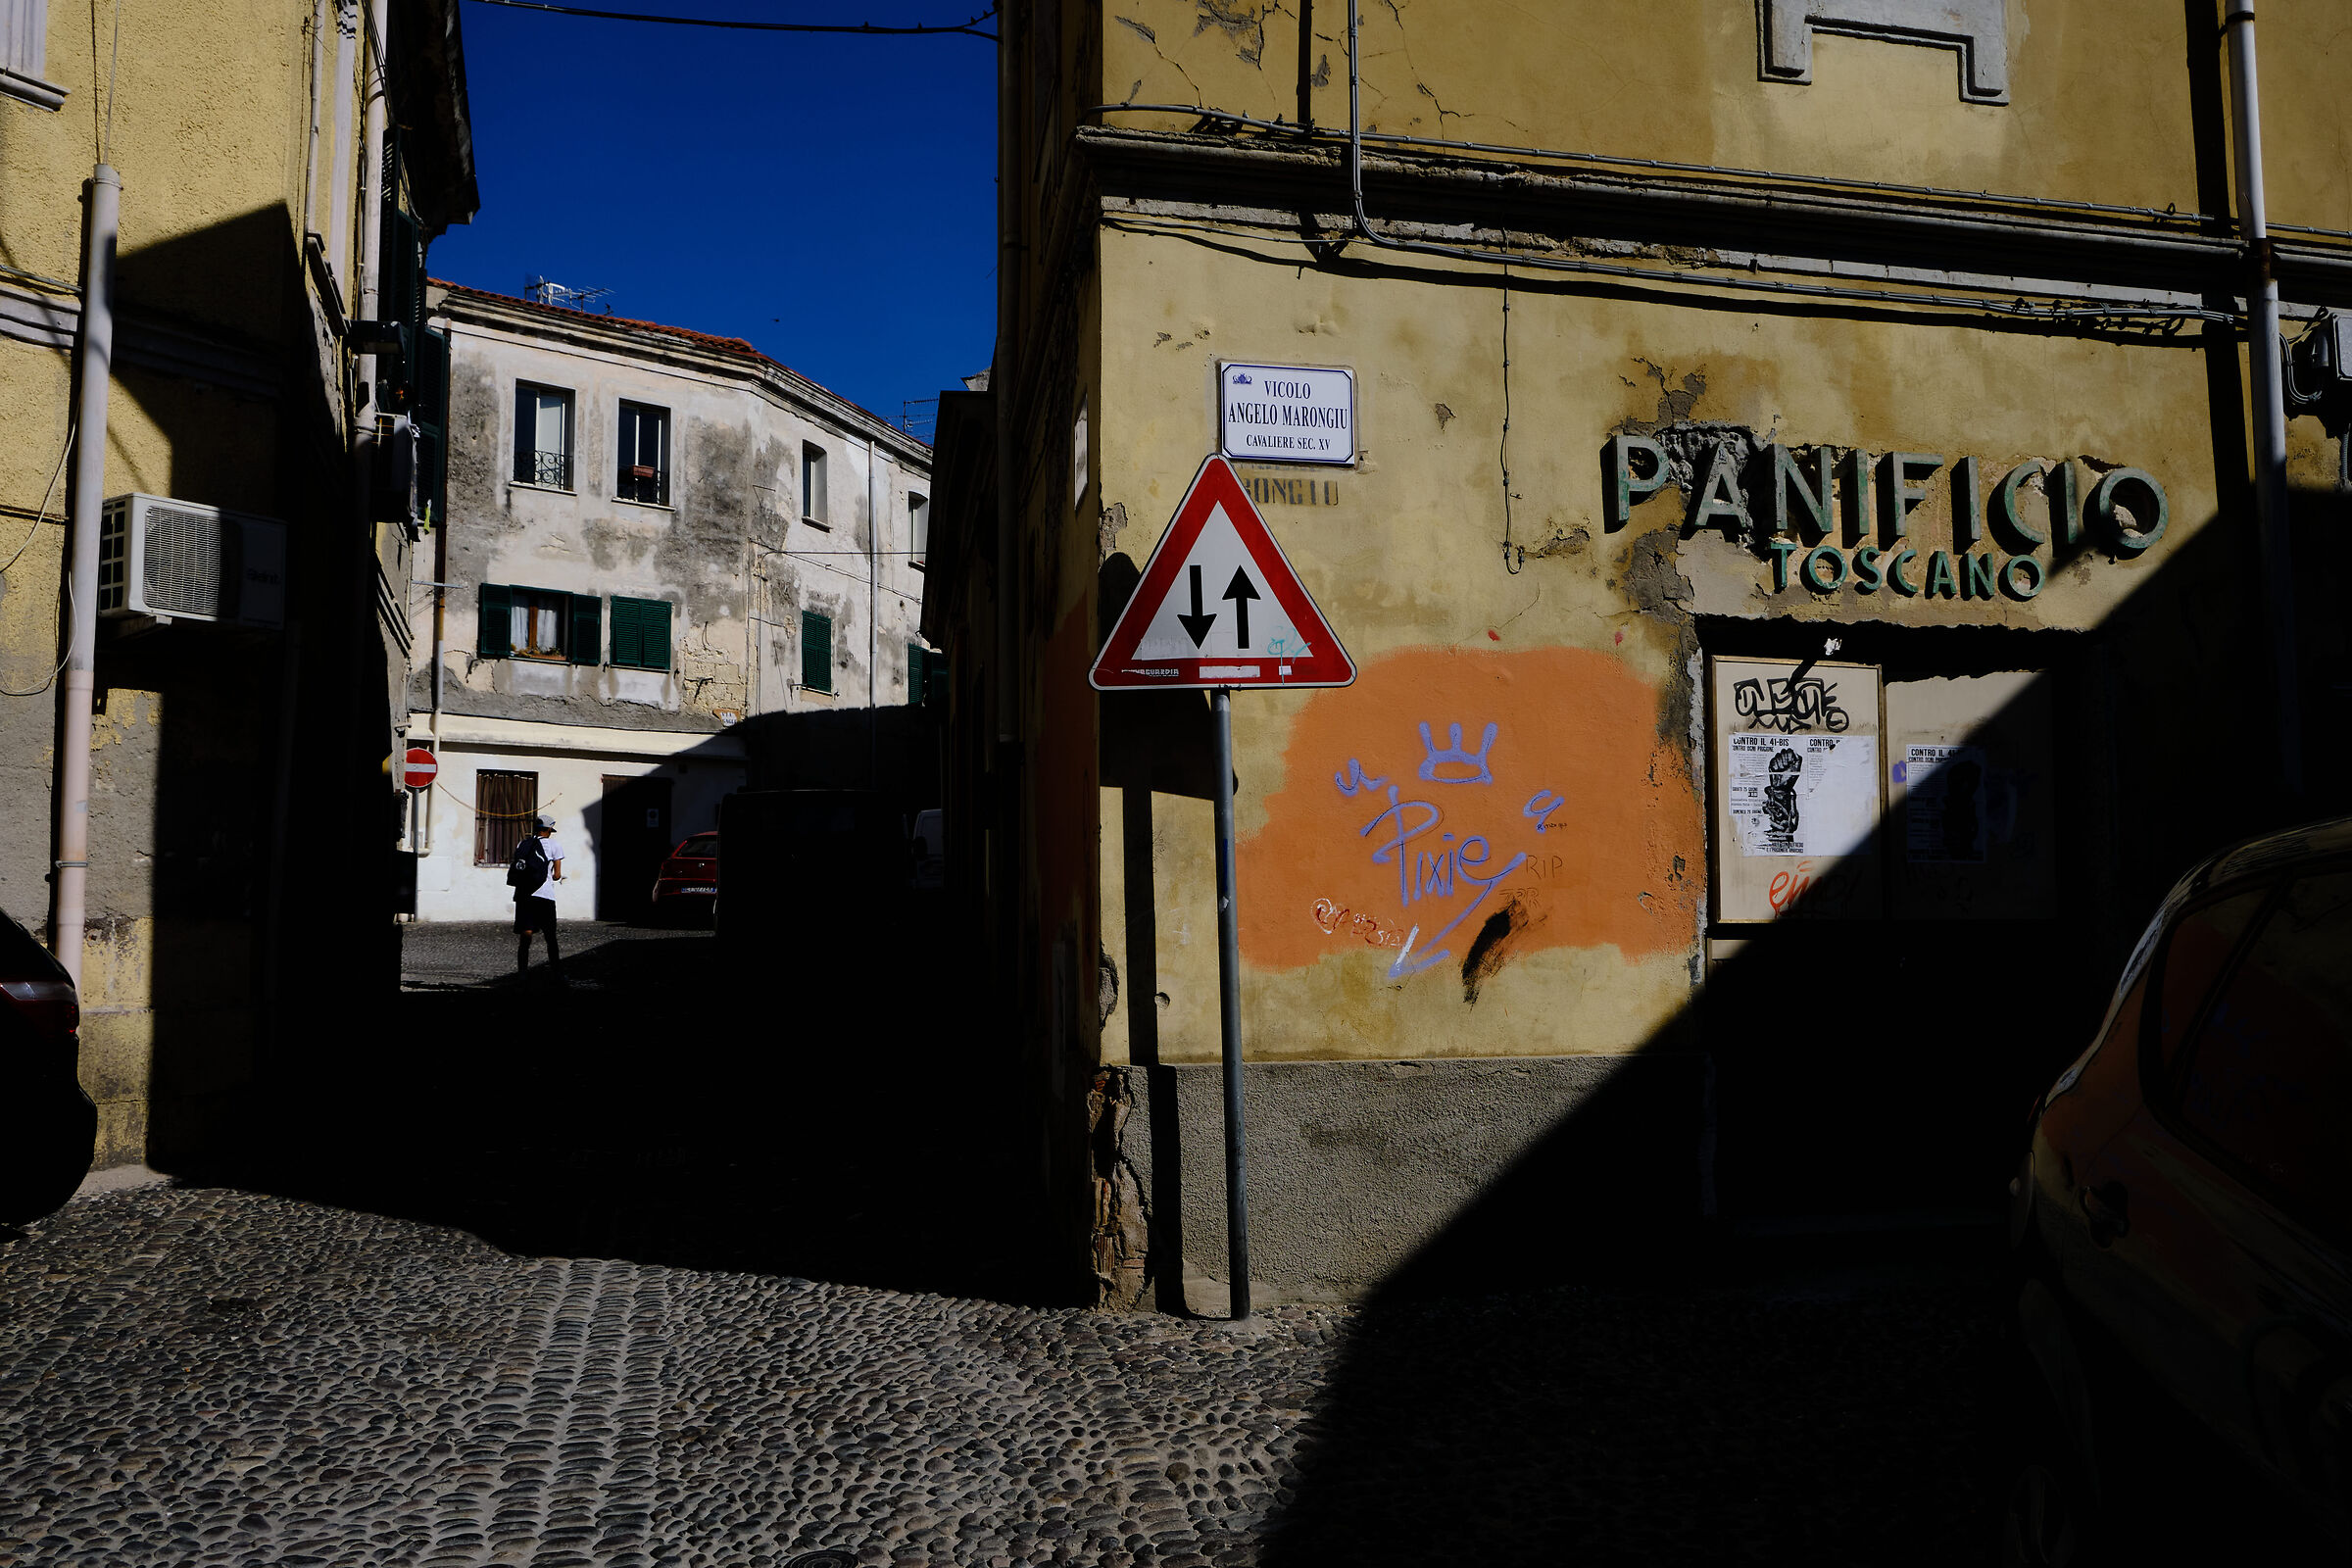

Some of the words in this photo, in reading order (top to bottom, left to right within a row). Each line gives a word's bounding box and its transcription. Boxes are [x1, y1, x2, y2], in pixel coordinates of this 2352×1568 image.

[1264, 380, 1311, 399] VICOLO
[1228, 403, 1278, 425] ANGELO
[1282, 405, 1348, 429] MARONGIU
[1246, 434, 1295, 449] CAVALIERE
[1297, 437, 1316, 450] SEC.
[1318, 438, 1331, 450] XV
[1612, 435, 2169, 551] PANIFICIO
[1771, 542, 2046, 598] TOSCANO
[1760, 737, 1767, 746] IL
[1769, 737, 1789, 747] 41-BIS
[1911, 748, 1936, 757] CONTRO
[1525, 855, 1563, 880] RIP
